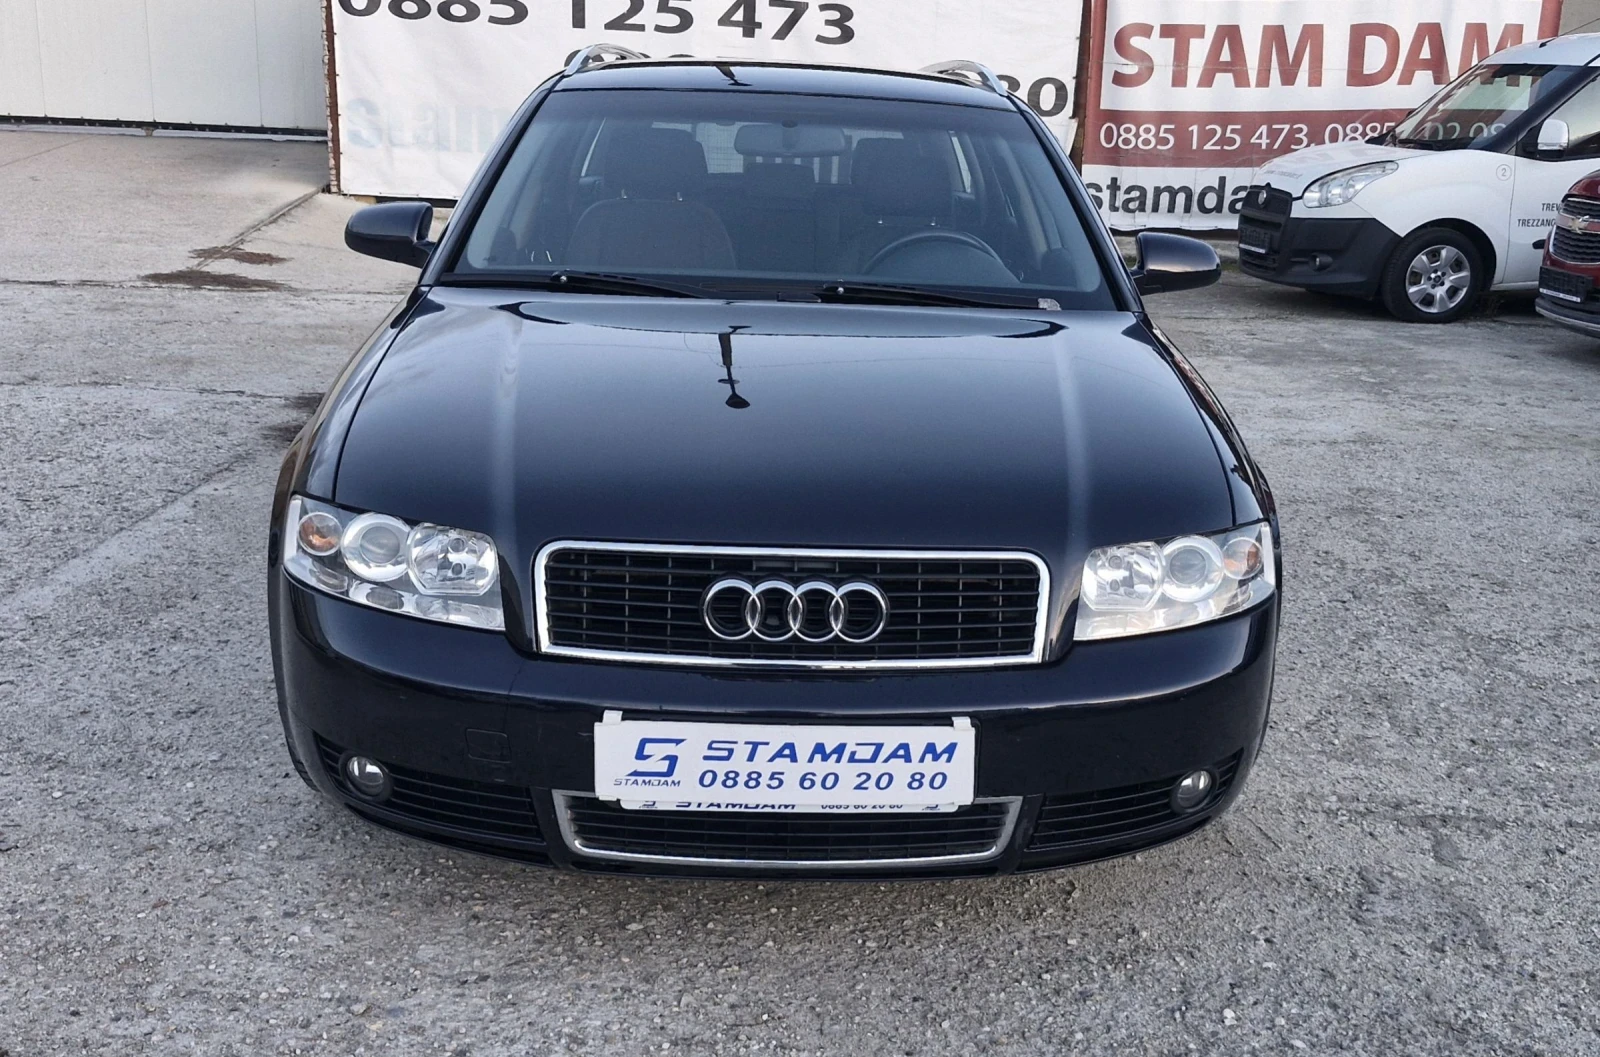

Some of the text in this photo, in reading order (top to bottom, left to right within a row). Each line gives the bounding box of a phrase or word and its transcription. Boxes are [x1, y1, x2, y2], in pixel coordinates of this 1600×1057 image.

[569, 0, 694, 33] 125
[718, 0, 855, 44] 473
[1111, 22, 1524, 88] STAM DAM
[1100, 123, 1175, 149] 0885
[1188, 124, 1241, 150] 125
[699, 769, 948, 791] 0885 60 20 80
